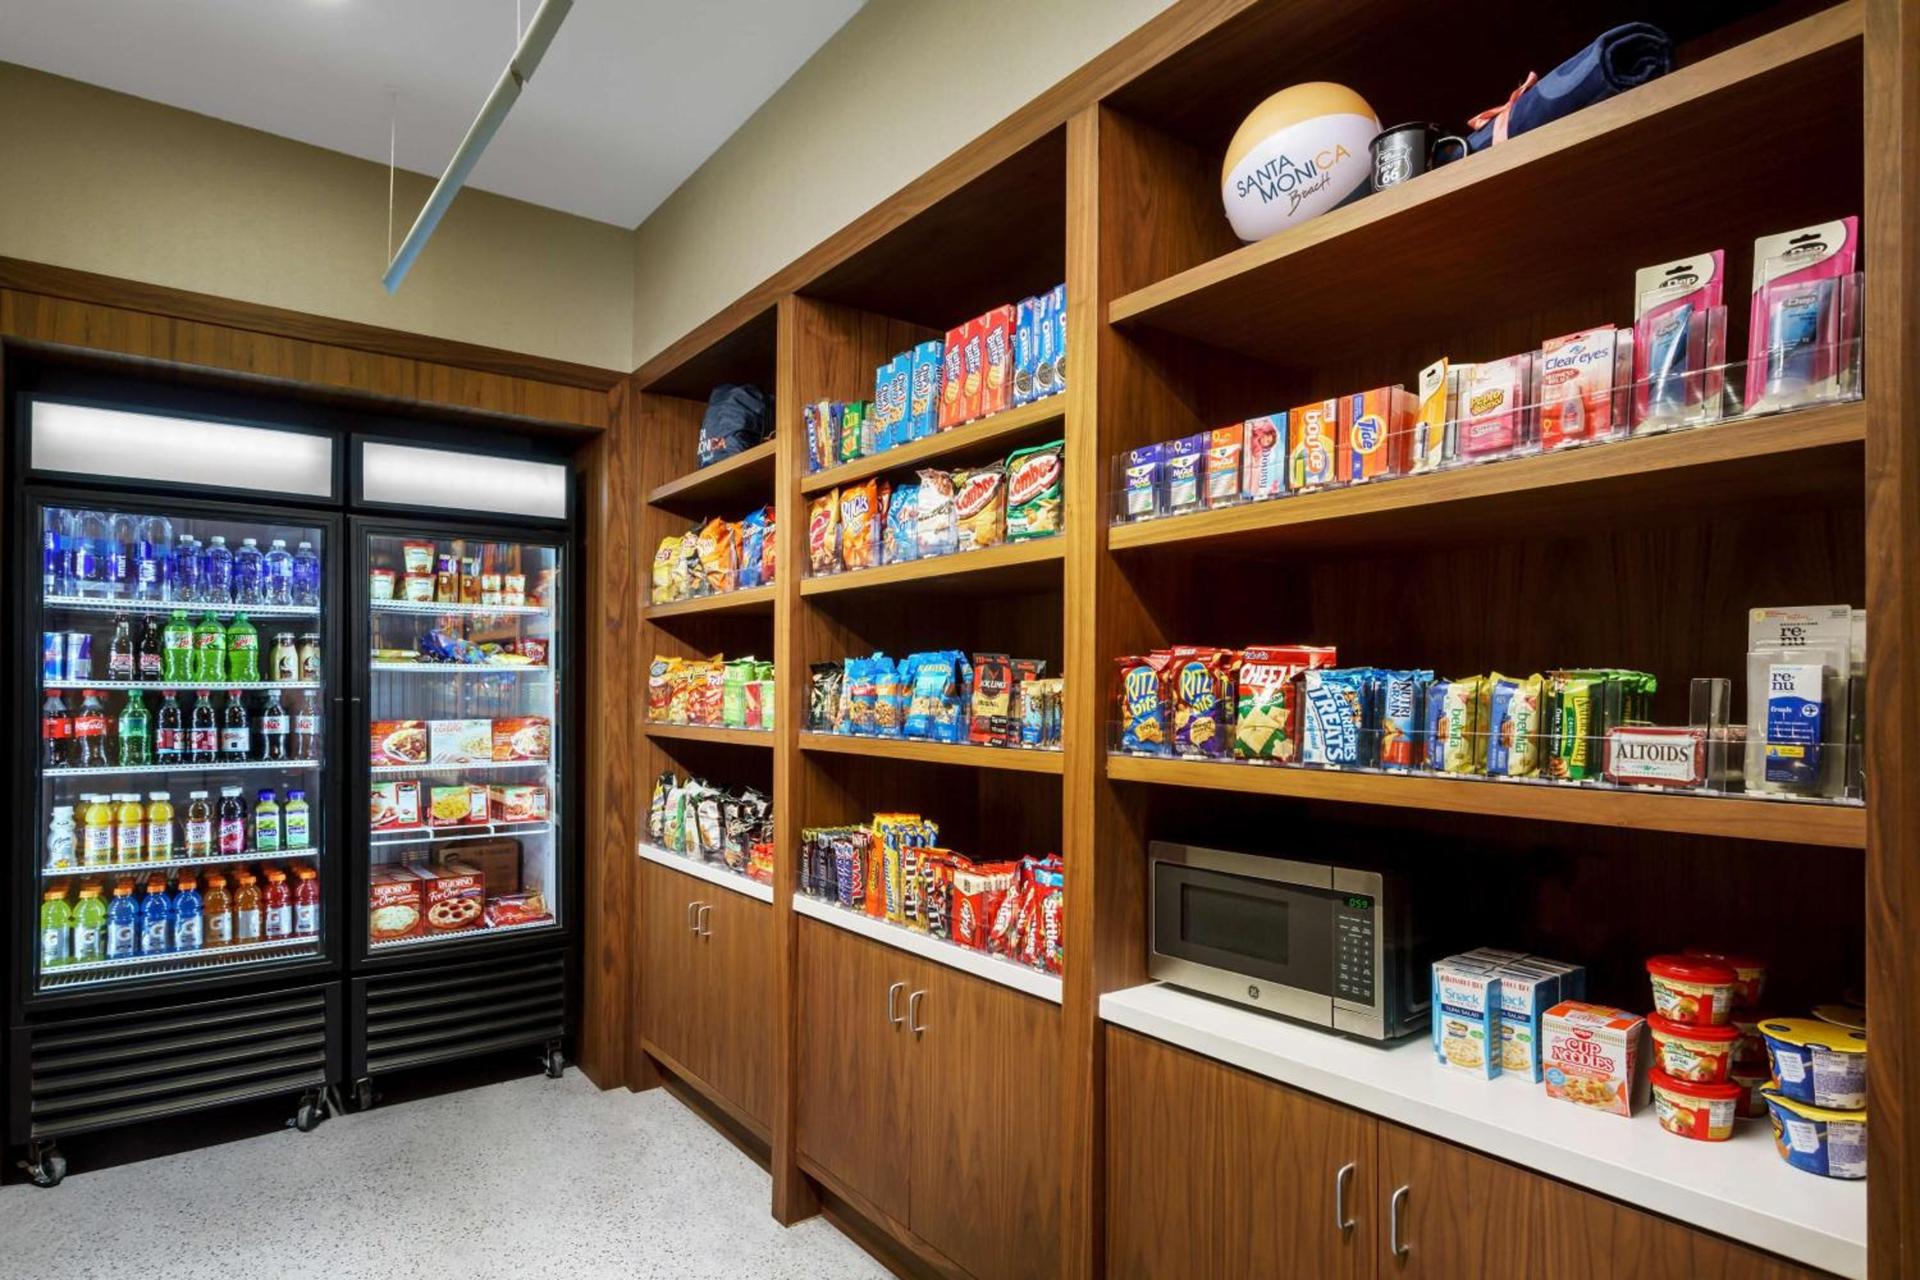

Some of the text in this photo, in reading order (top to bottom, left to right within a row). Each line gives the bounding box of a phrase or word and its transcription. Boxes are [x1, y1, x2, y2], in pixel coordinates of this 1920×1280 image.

[1237, 154, 1295, 198] SANTA
[1259, 144, 1350, 204] MONICA
[1382, 168, 1399, 184] 66
[1545, 347, 1609, 371] Clear eyes
[1304, 410, 1323, 469] bounce
[1358, 418, 1376, 449] Tide
[957, 475, 996, 512] Combos
[1009, 458, 1055, 496] Combos
[1126, 669, 1159, 699] RITZ
[1182, 665, 1210, 698] RITZ
[1131, 696, 1158, 716] bits
[1192, 694, 1216, 714] bits
[1390, 681, 1401, 718] GRAIN
[1400, 683, 1410, 718] NUTRI
[1307, 686, 1344, 762] TREATS
[1451, 708, 1465, 748] belvita
[1516, 711, 1531, 753] belvita
[1616, 744, 1689, 762] ALTOIDS
[1044, 897, 1059, 957] Skittles
[1552, 1046, 1615, 1073] NOODLES
[1566, 1038, 1602, 1056] CUP
